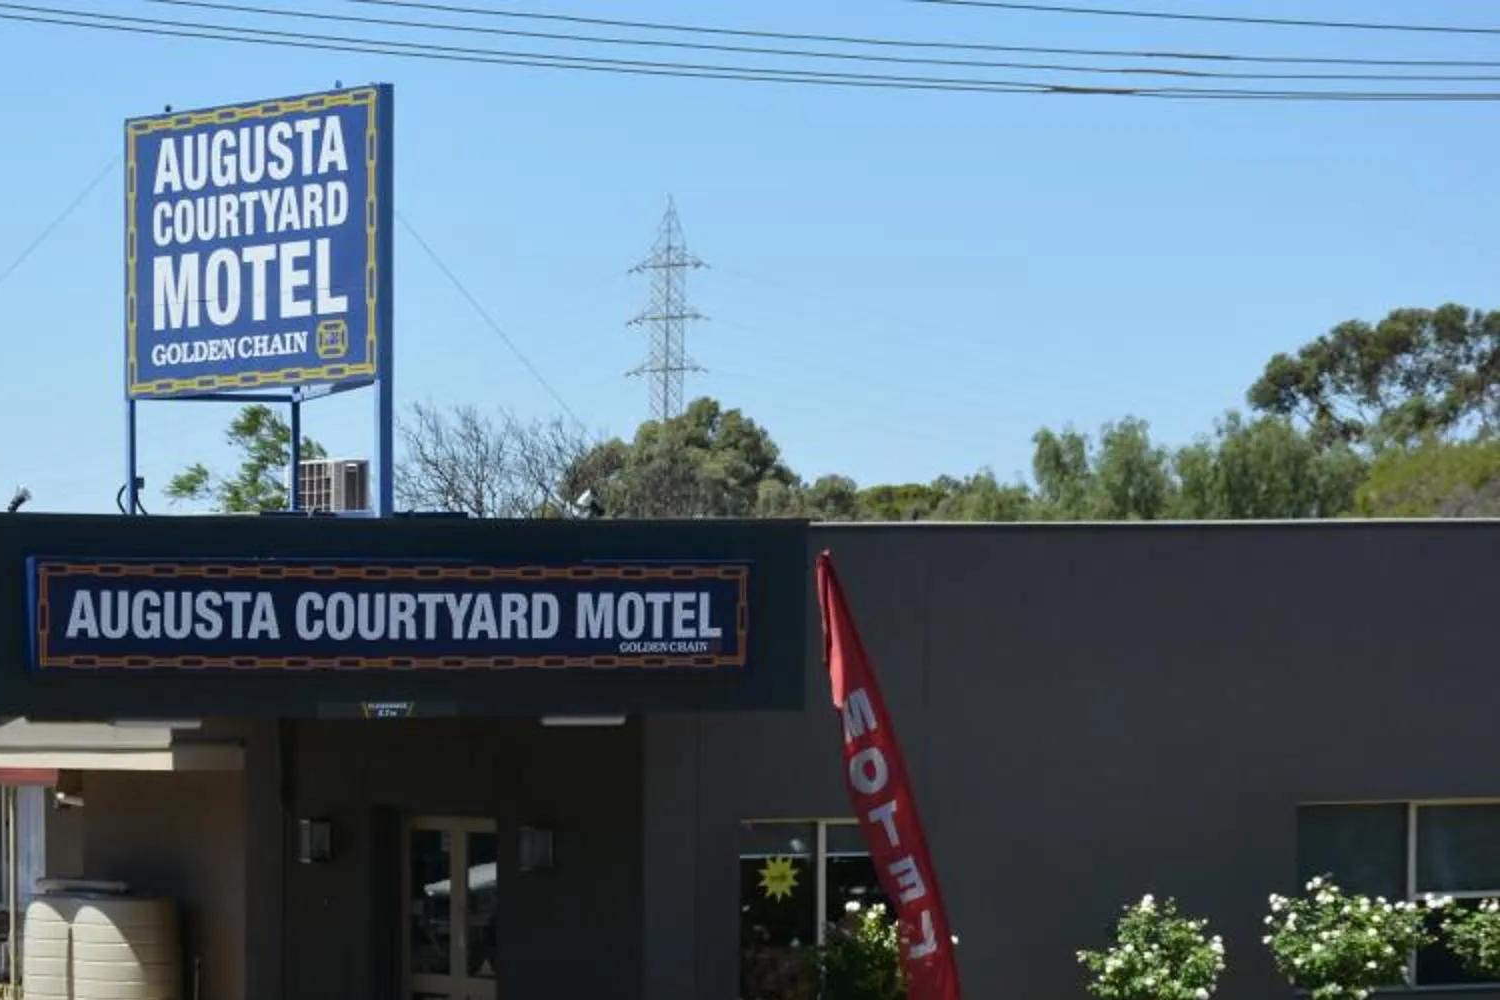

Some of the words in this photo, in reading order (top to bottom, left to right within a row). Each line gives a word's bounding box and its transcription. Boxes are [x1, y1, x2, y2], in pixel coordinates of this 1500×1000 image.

[153, 115, 349, 195] AUGUSTA
[153, 181, 349, 247] COURTYARD
[153, 238, 349, 331] MOTEL
[65, 590, 280, 640] AUGUSTA
[295, 590, 560, 641] COURTYARD
[575, 591, 722, 640] MOTEL
